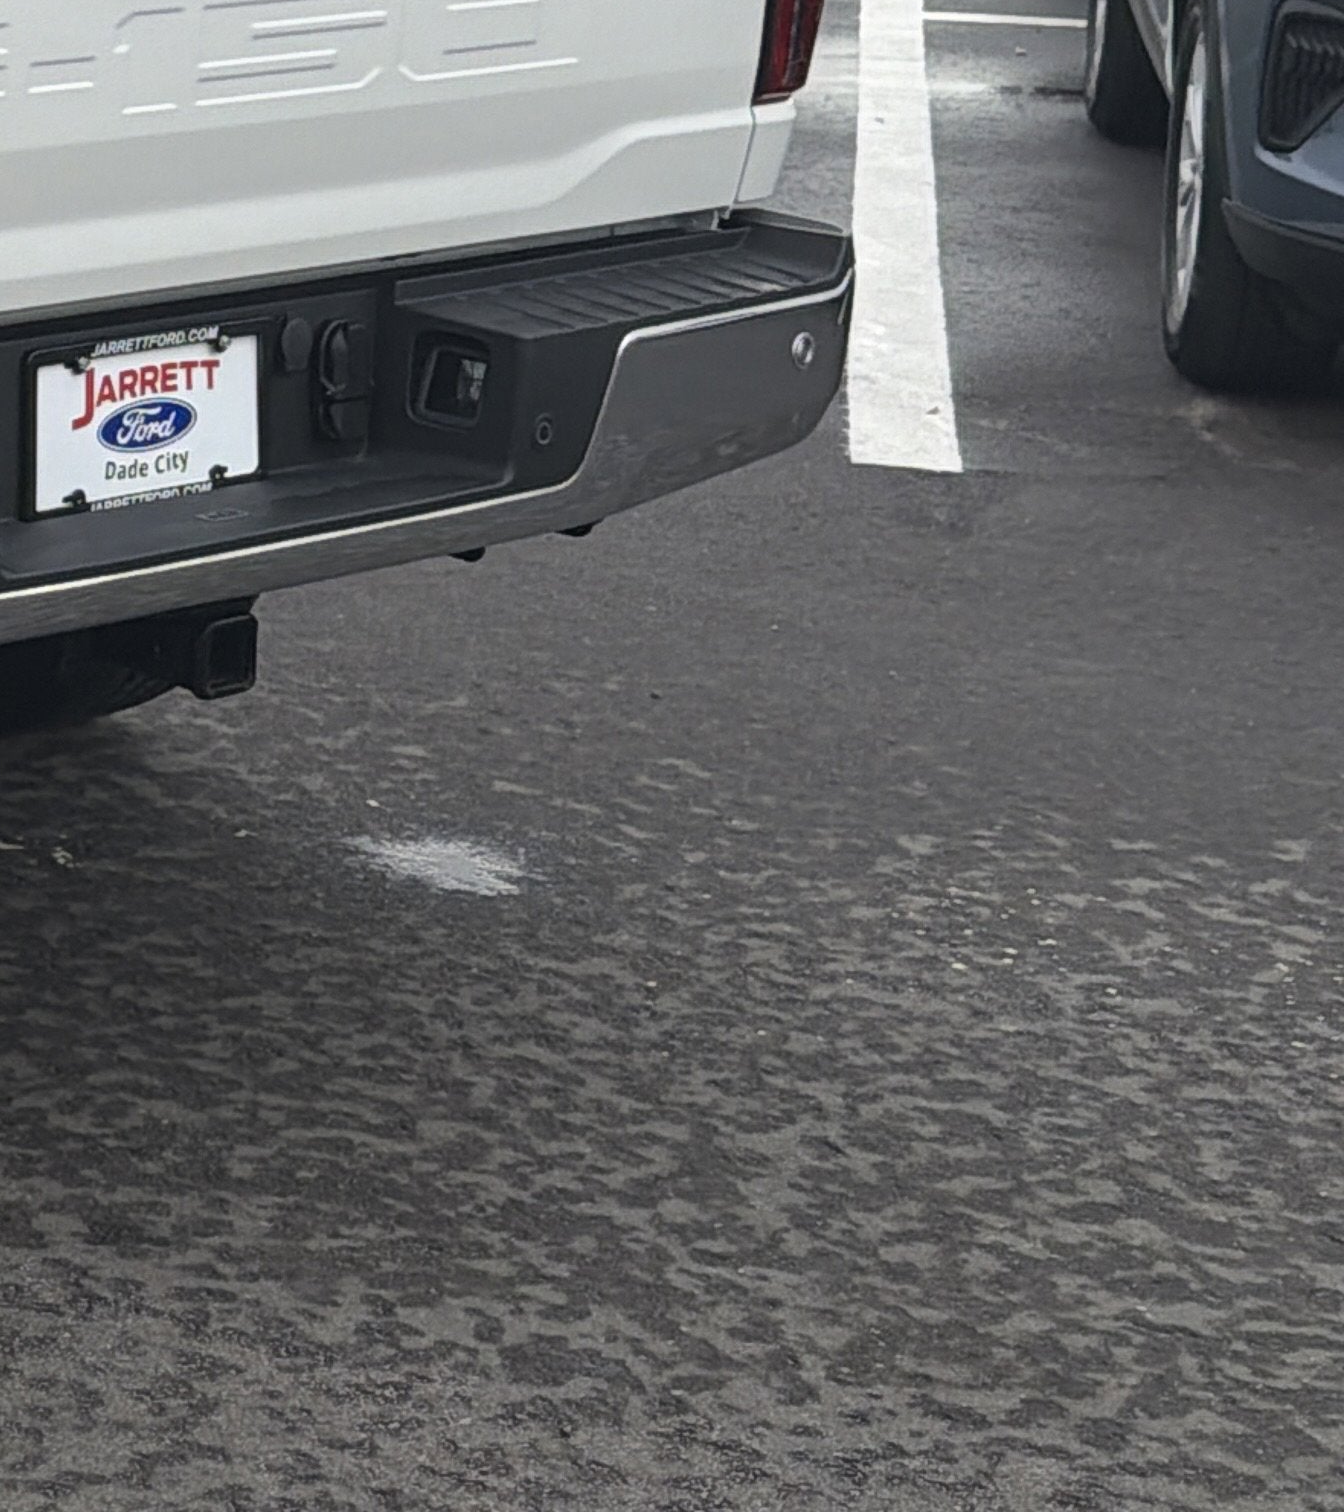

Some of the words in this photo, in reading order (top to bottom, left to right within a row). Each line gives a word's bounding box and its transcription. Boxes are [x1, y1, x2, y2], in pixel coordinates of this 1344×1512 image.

[92, 326, 219, 357] JARRETTFORD.COM
[72, 359, 220, 431] JARRETT
[116, 406, 176, 445] Ford
[104, 459, 149, 480] Dade
[155, 451, 189, 474] City
